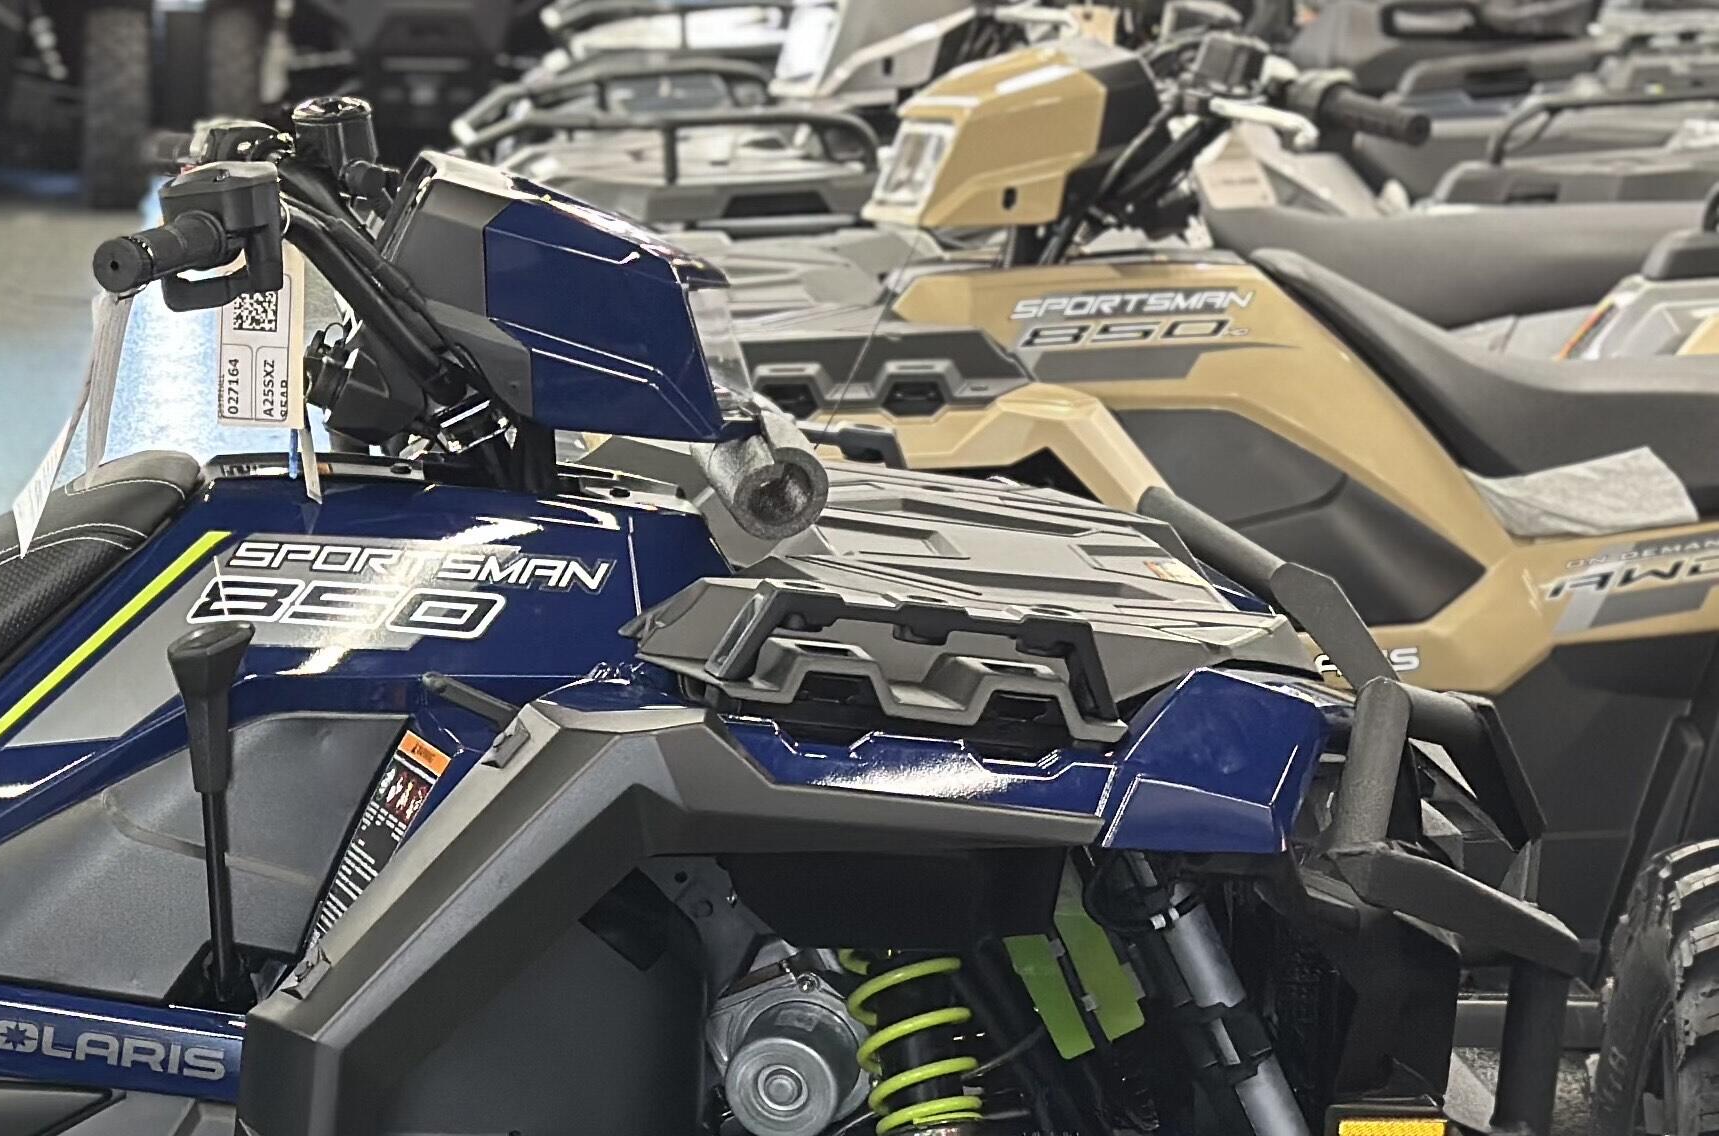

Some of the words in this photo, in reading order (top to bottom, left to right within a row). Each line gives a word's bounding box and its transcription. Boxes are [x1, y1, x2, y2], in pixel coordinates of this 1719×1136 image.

[1010, 290, 1254, 320] SPORTSMAN
[1020, 317, 1232, 349] 850
[226, 358, 240, 415] 027164
[262, 359, 276, 418] A25SXZ
[228, 541, 614, 593] SPORTSMAN
[187, 575, 507, 640] 850
